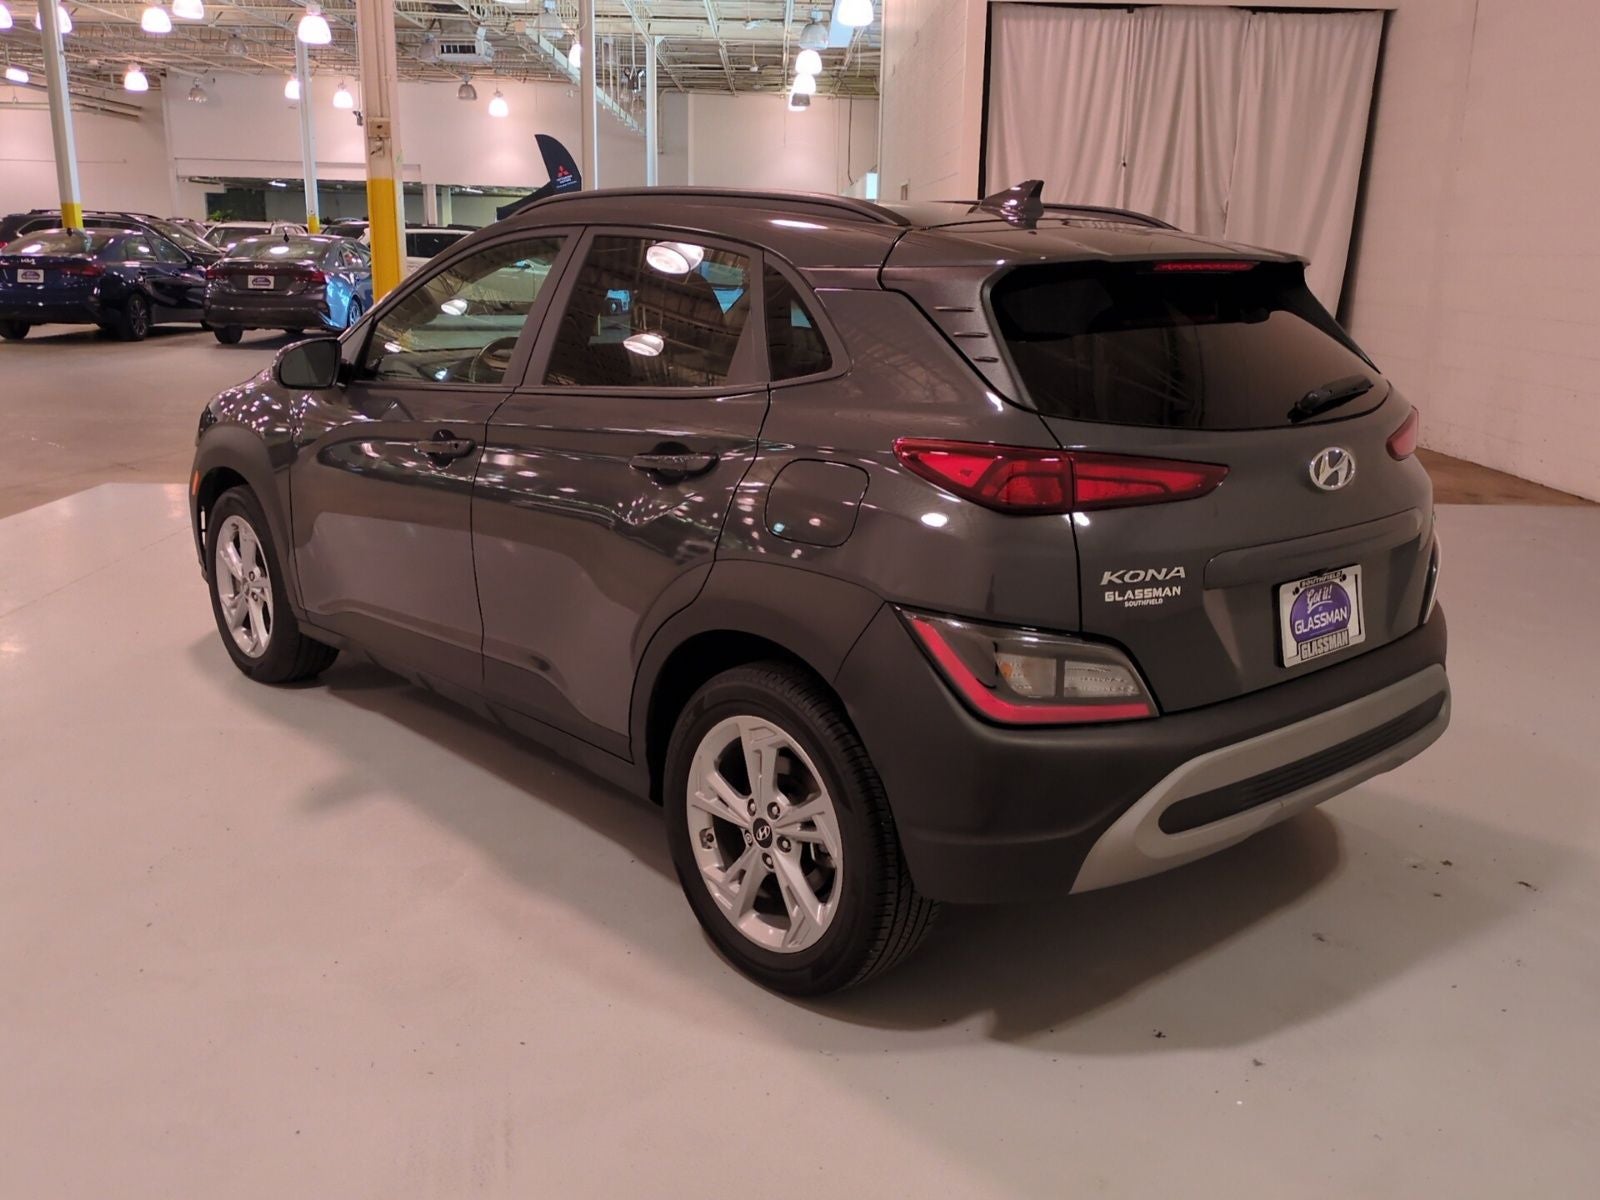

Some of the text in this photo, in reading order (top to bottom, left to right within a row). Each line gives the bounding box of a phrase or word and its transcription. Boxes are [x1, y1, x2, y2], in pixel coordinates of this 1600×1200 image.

[1100, 567, 1185, 585] KONA
[1105, 586, 1181, 602] GLASSMAN
[1124, 598, 1163, 607] SOUTHFIELD
[1294, 606, 1348, 635] GLASSMAN
[1301, 630, 1349, 660] GLASSMAN
